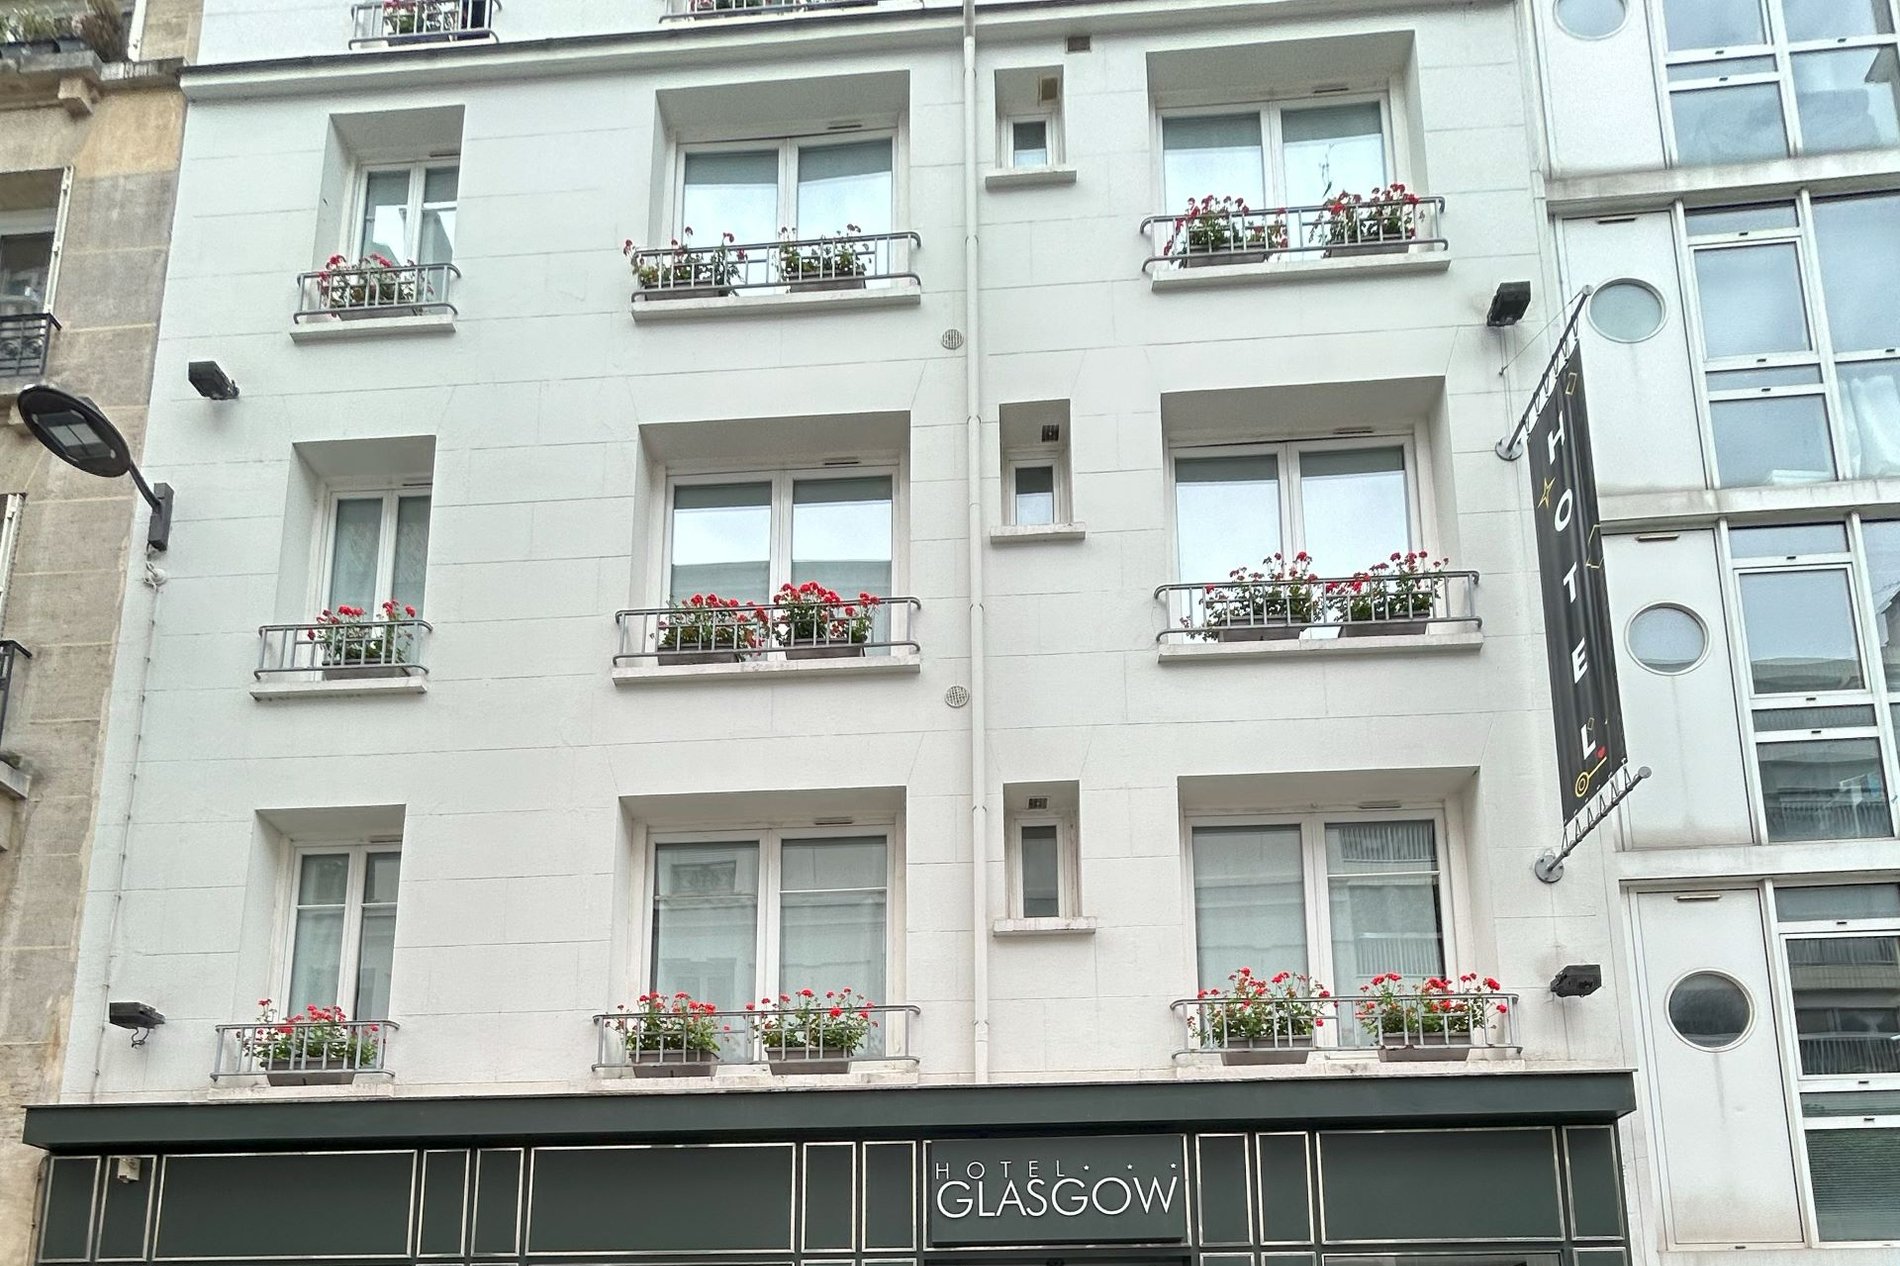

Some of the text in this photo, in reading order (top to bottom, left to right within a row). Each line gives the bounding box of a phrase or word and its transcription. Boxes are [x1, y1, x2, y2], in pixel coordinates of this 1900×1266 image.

[1547, 410, 1597, 760] HOTEL
[935, 1160, 1066, 1180] HOTEL
[936, 1176, 1178, 1219] GLASGOW
